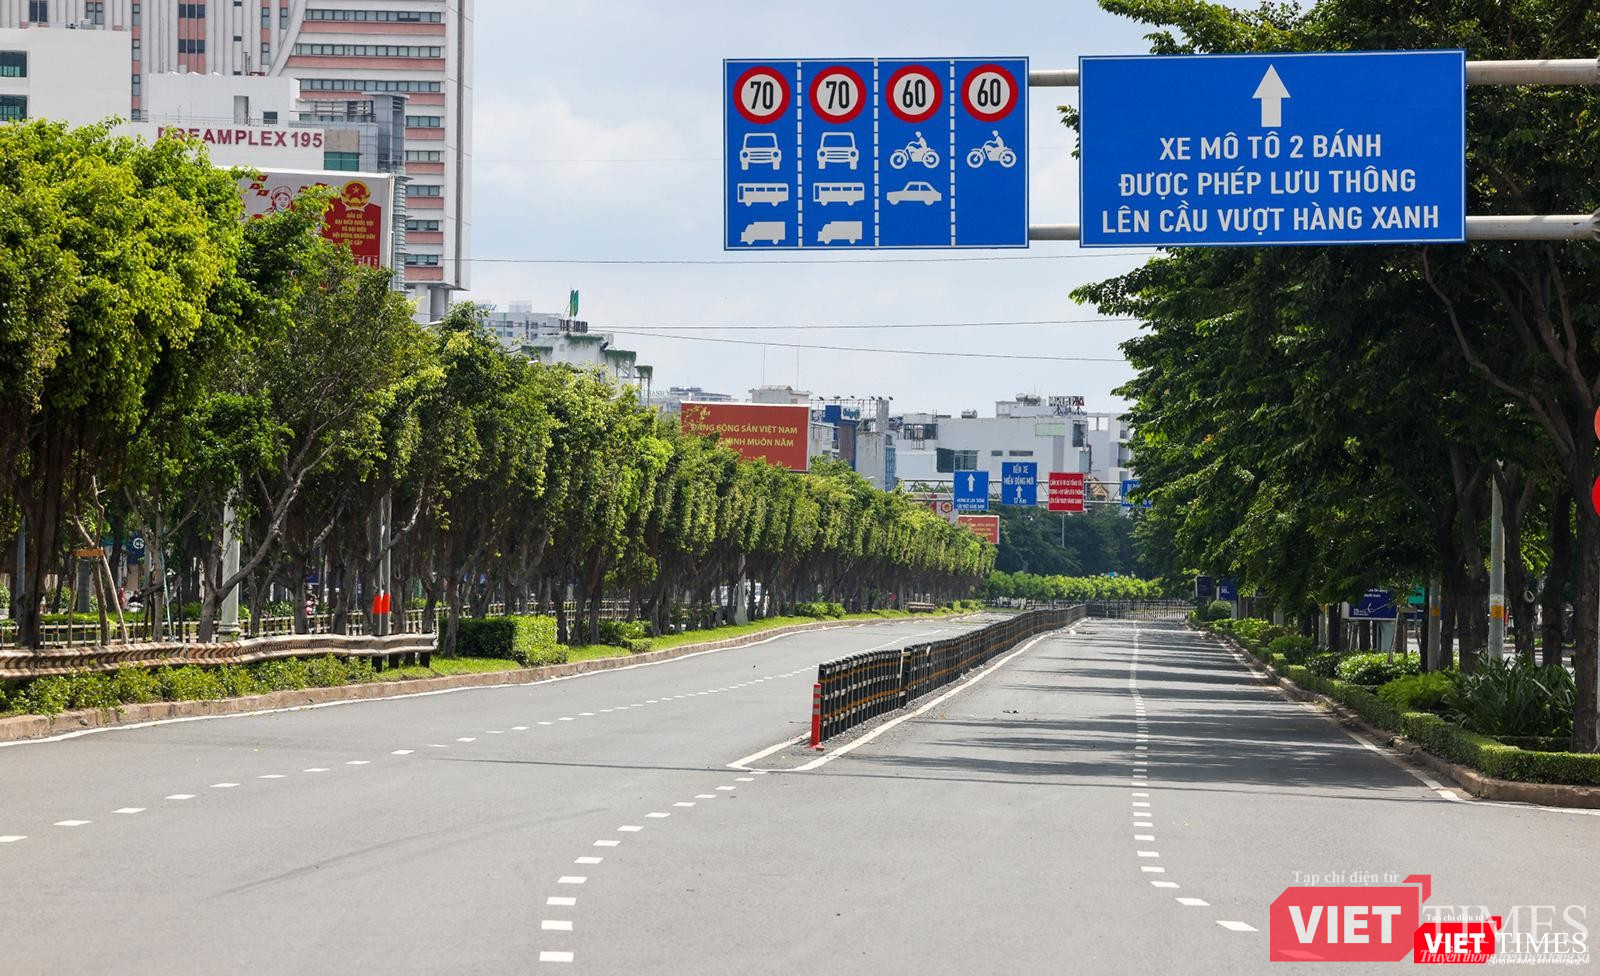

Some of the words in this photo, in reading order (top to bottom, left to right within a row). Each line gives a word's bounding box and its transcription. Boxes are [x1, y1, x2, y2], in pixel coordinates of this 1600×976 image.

[750, 81, 774, 110] 70
[826, 80, 850, 110] 70
[902, 79, 927, 108] 60
[977, 78, 1001, 107] 60
[291, 131, 323, 148] 195
[1159, 137, 1191, 161] XE
[1200, 131, 1239, 160] MÔ
[1247, 130, 1281, 160] TÔ
[1289, 135, 1304, 159] 2
[1313, 129, 1382, 158] BÁNH
[1118, 172, 1189, 200] ĐƯỢC
[1197, 165, 1262, 196] PHÉP
[1270, 170, 1320, 195] LƯU
[1329, 165, 1417, 194] THÔNG
[1102, 205, 1150, 234] LÊN
[1159, 200, 1208, 233] CẦU
[1217, 206, 1284, 236] VƯỢT
[1293, 201, 1363, 231] HÀNG
[1371, 205, 1439, 229] XANH
[741, 422, 758, 433] SẢN
[759, 424, 777, 435] VIỆT
[778, 425, 798, 435] NAM
